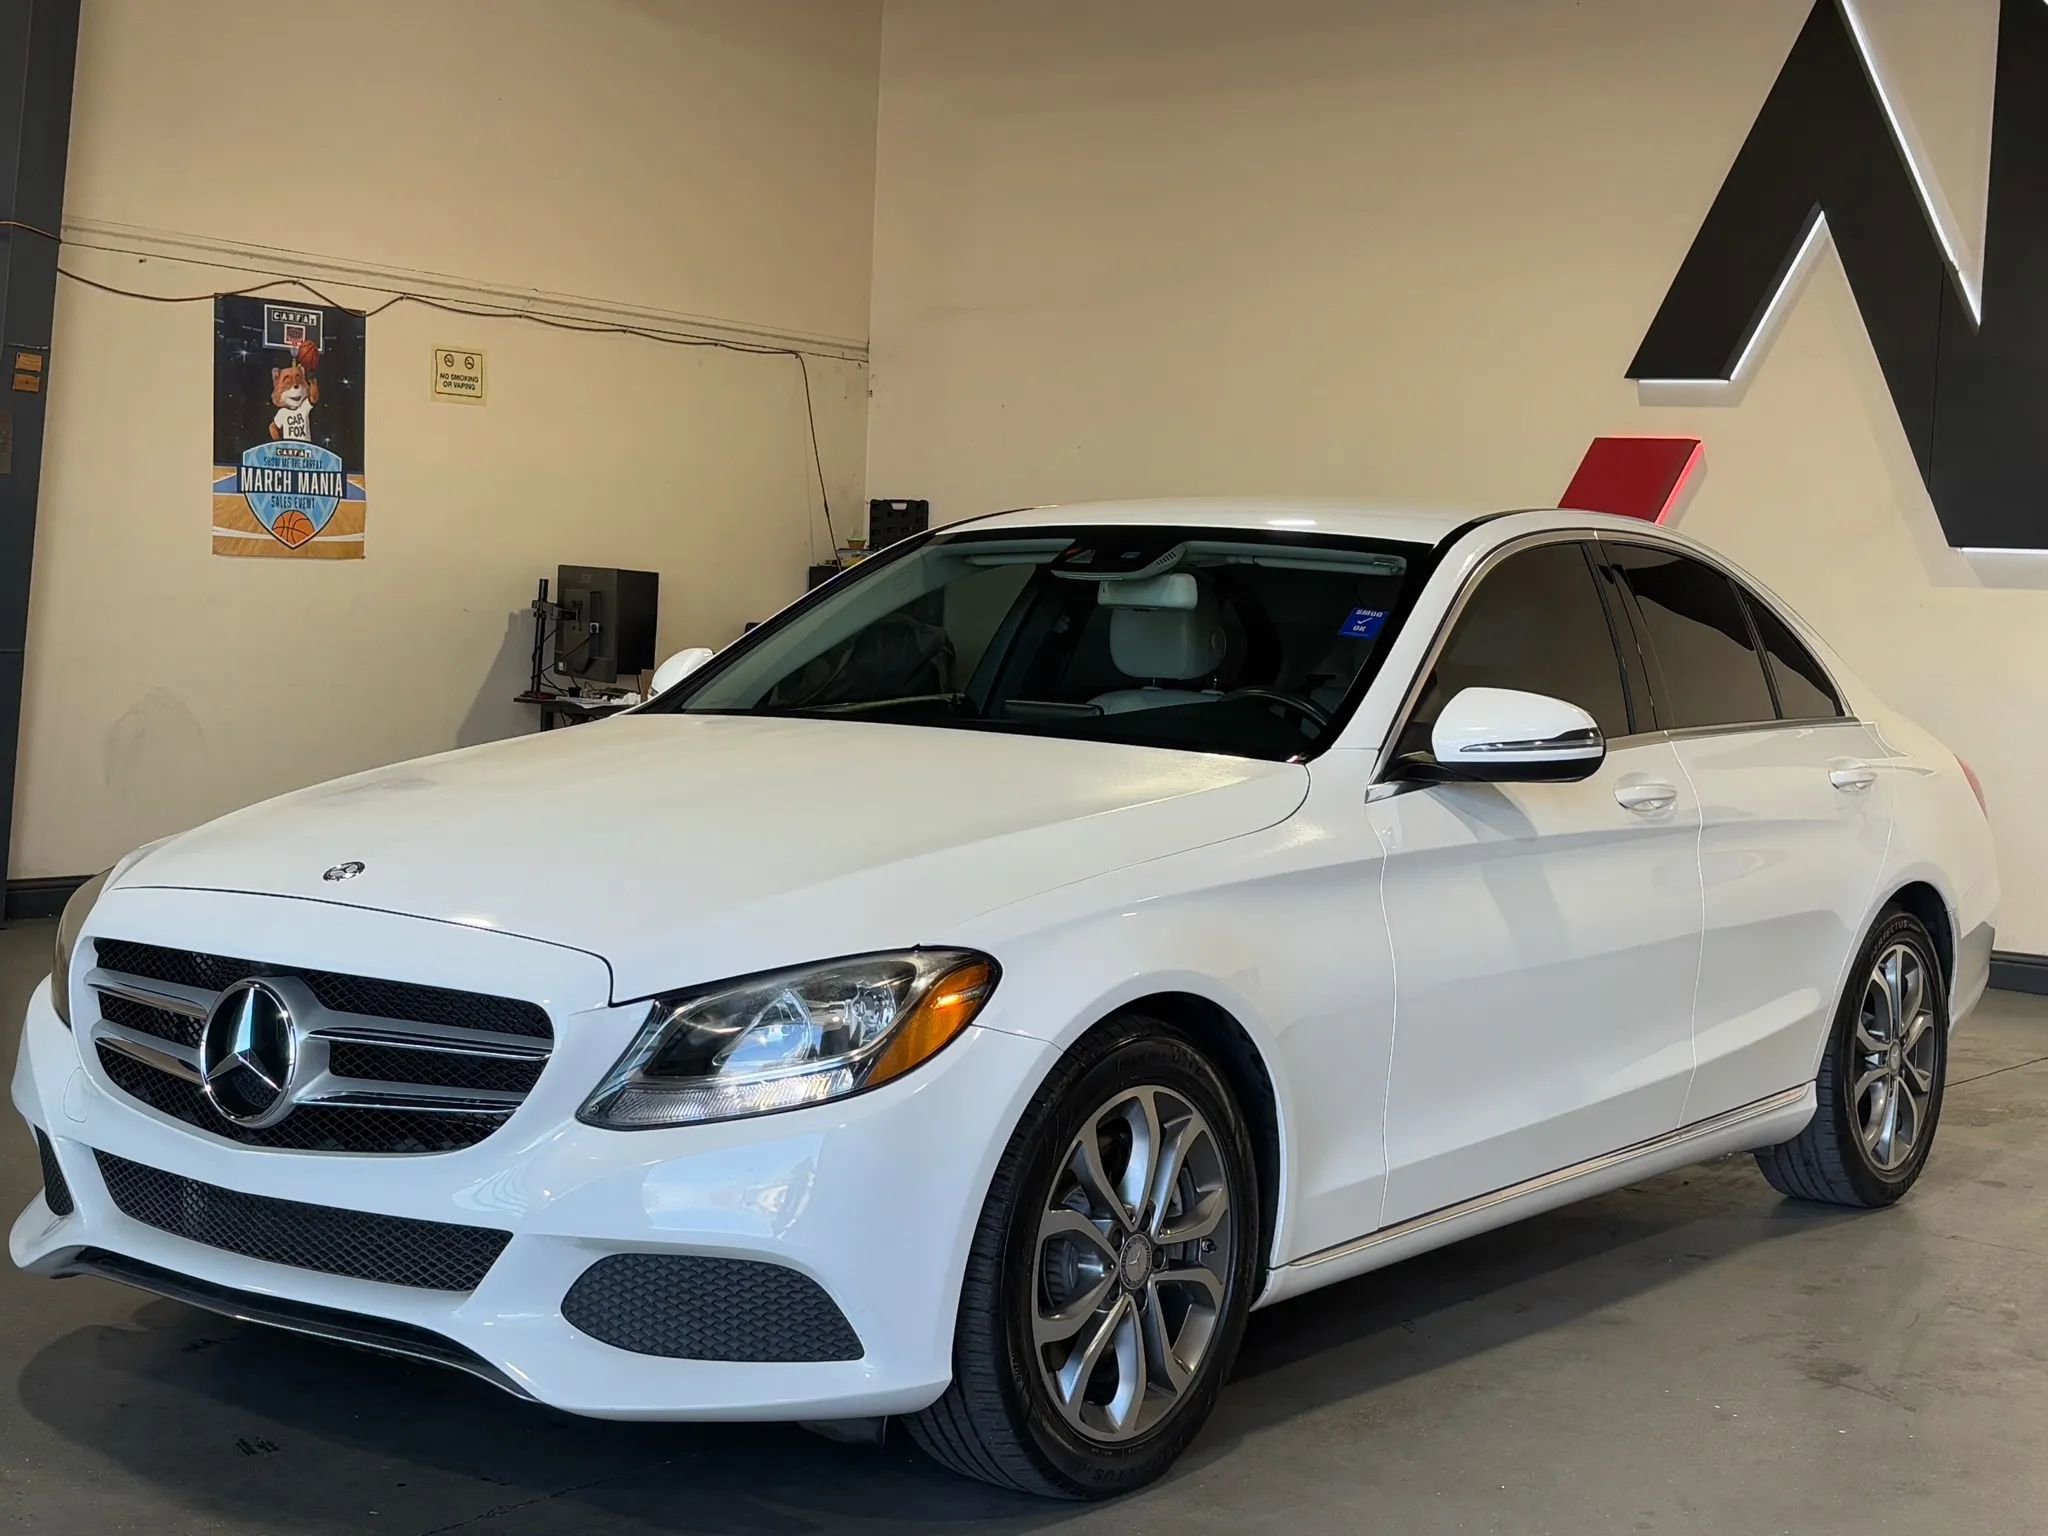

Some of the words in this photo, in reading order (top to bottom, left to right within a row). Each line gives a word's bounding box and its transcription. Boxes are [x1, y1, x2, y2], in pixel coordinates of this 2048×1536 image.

[272, 311, 317, 325] CARFAX
[439, 372, 449, 380] NO
[451, 374, 478, 383] SMOKING
[453, 382, 475, 390] VAPING
[287, 413, 305, 426] CAR
[288, 424, 306, 437] FOX
[277, 448, 312, 458] CARFAX
[264, 456, 280, 467] SHOW
[282, 458, 290, 467] ME
[291, 458, 301, 468] THE
[303, 460, 322, 469] CARFAX
[240, 467, 292, 493] MARCH
[298, 471, 343, 497] MANIA
[271, 495, 292, 508] SALES
[294, 496, 316, 509] EVENT
